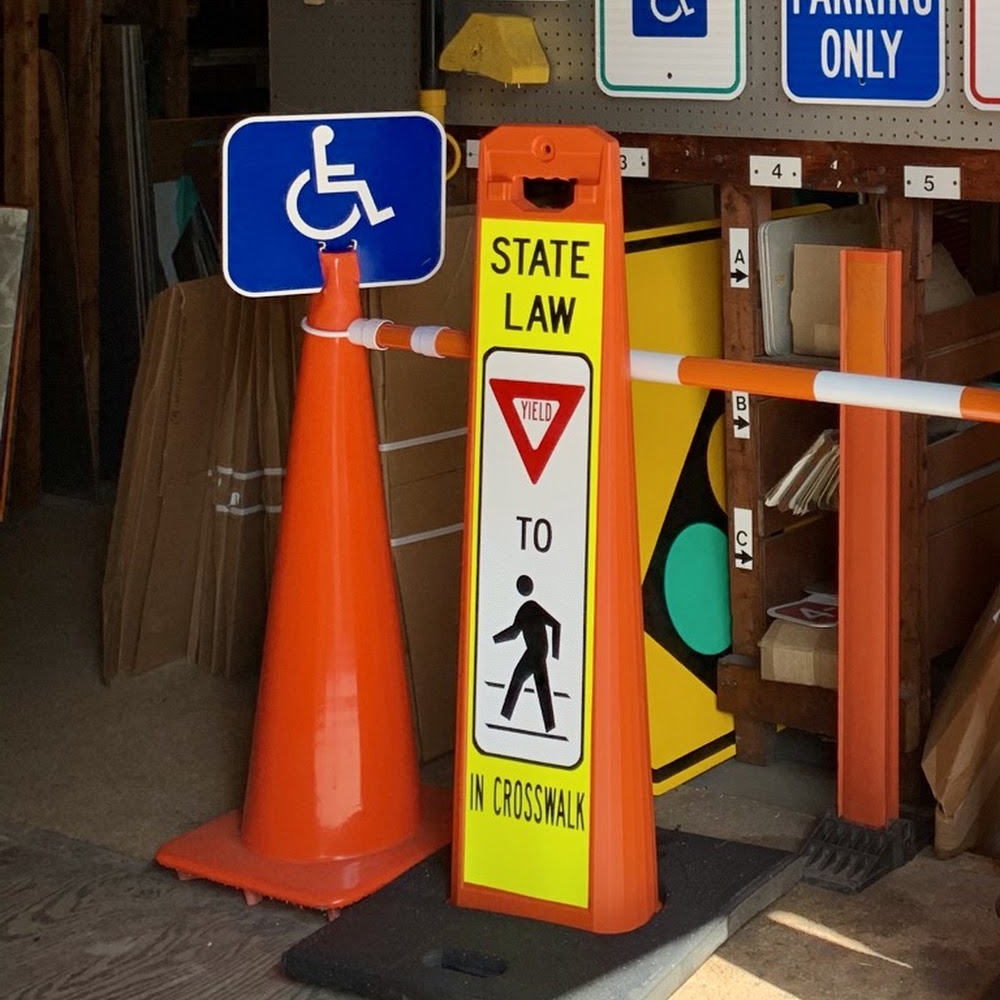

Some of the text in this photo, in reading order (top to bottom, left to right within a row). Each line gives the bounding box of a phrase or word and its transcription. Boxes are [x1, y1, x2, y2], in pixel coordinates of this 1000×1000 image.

[820, 28, 903, 80] ONLY
[619, 155, 627, 170] 3
[771, 163, 783, 179] 4
[923, 175, 934, 192] 5
[490, 236, 590, 279] STATE
[734, 249, 746, 265] A
[504, 294, 576, 335] LAW
[520, 401, 552, 422] YIELD
[736, 396, 747, 411] B
[517, 516, 552, 553] TO
[736, 531, 748, 546] C
[469, 773, 586, 832] IN CROSSWALK
